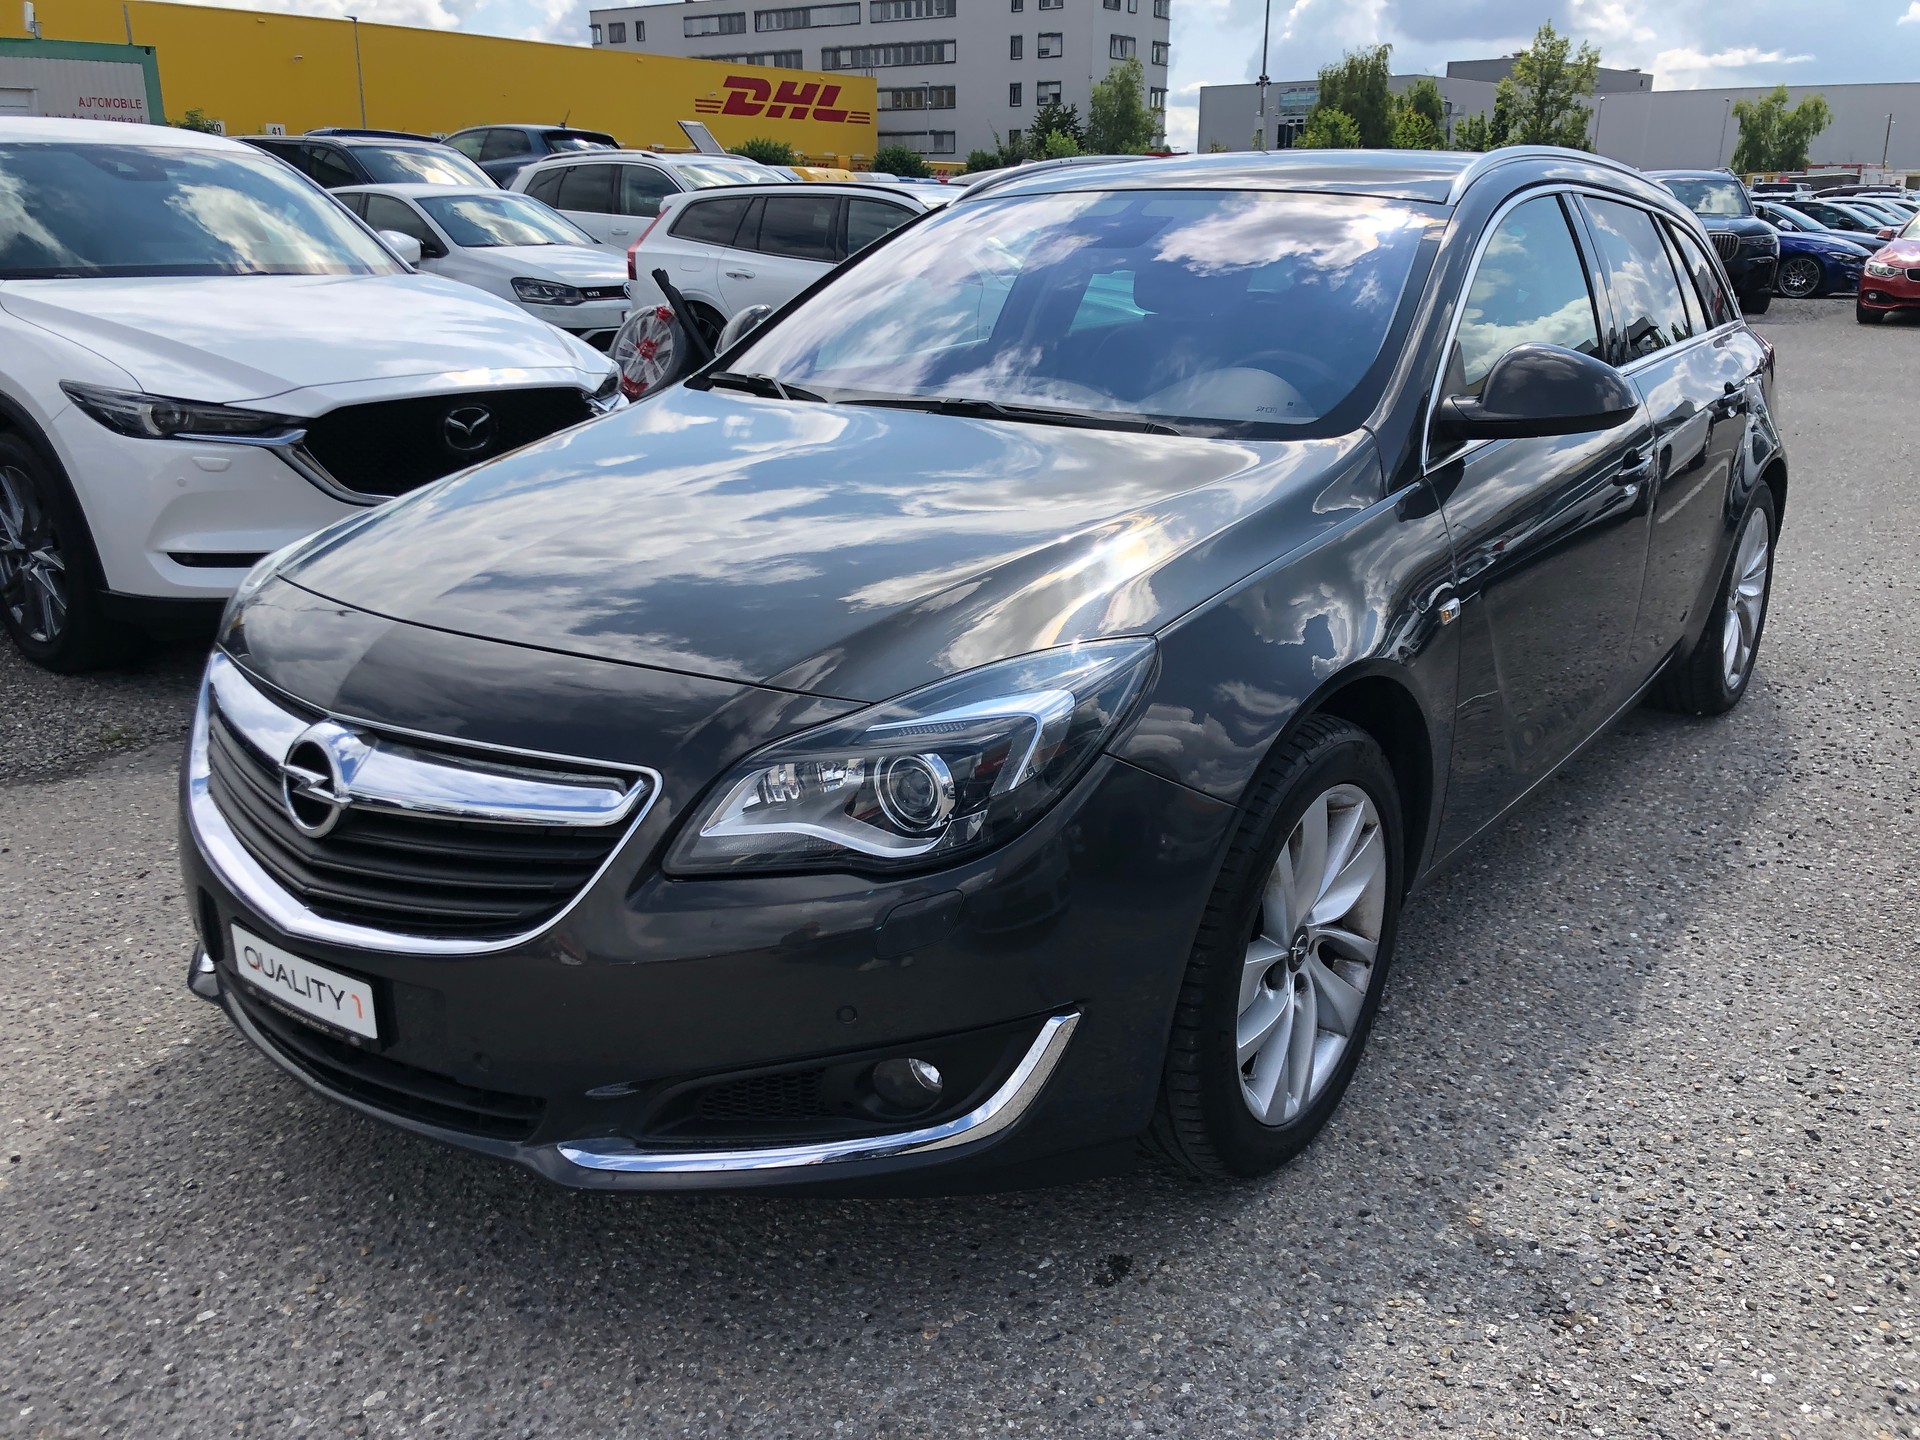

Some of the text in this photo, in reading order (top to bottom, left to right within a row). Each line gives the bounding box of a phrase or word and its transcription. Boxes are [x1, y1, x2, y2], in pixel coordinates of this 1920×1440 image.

[78, 96, 143, 109] AUTOMOBILE
[722, 75, 849, 122] DHL
[271, 127, 282, 136] 41
[244, 945, 346, 1011] QUALITY
[351, 993, 363, 1020] 1
